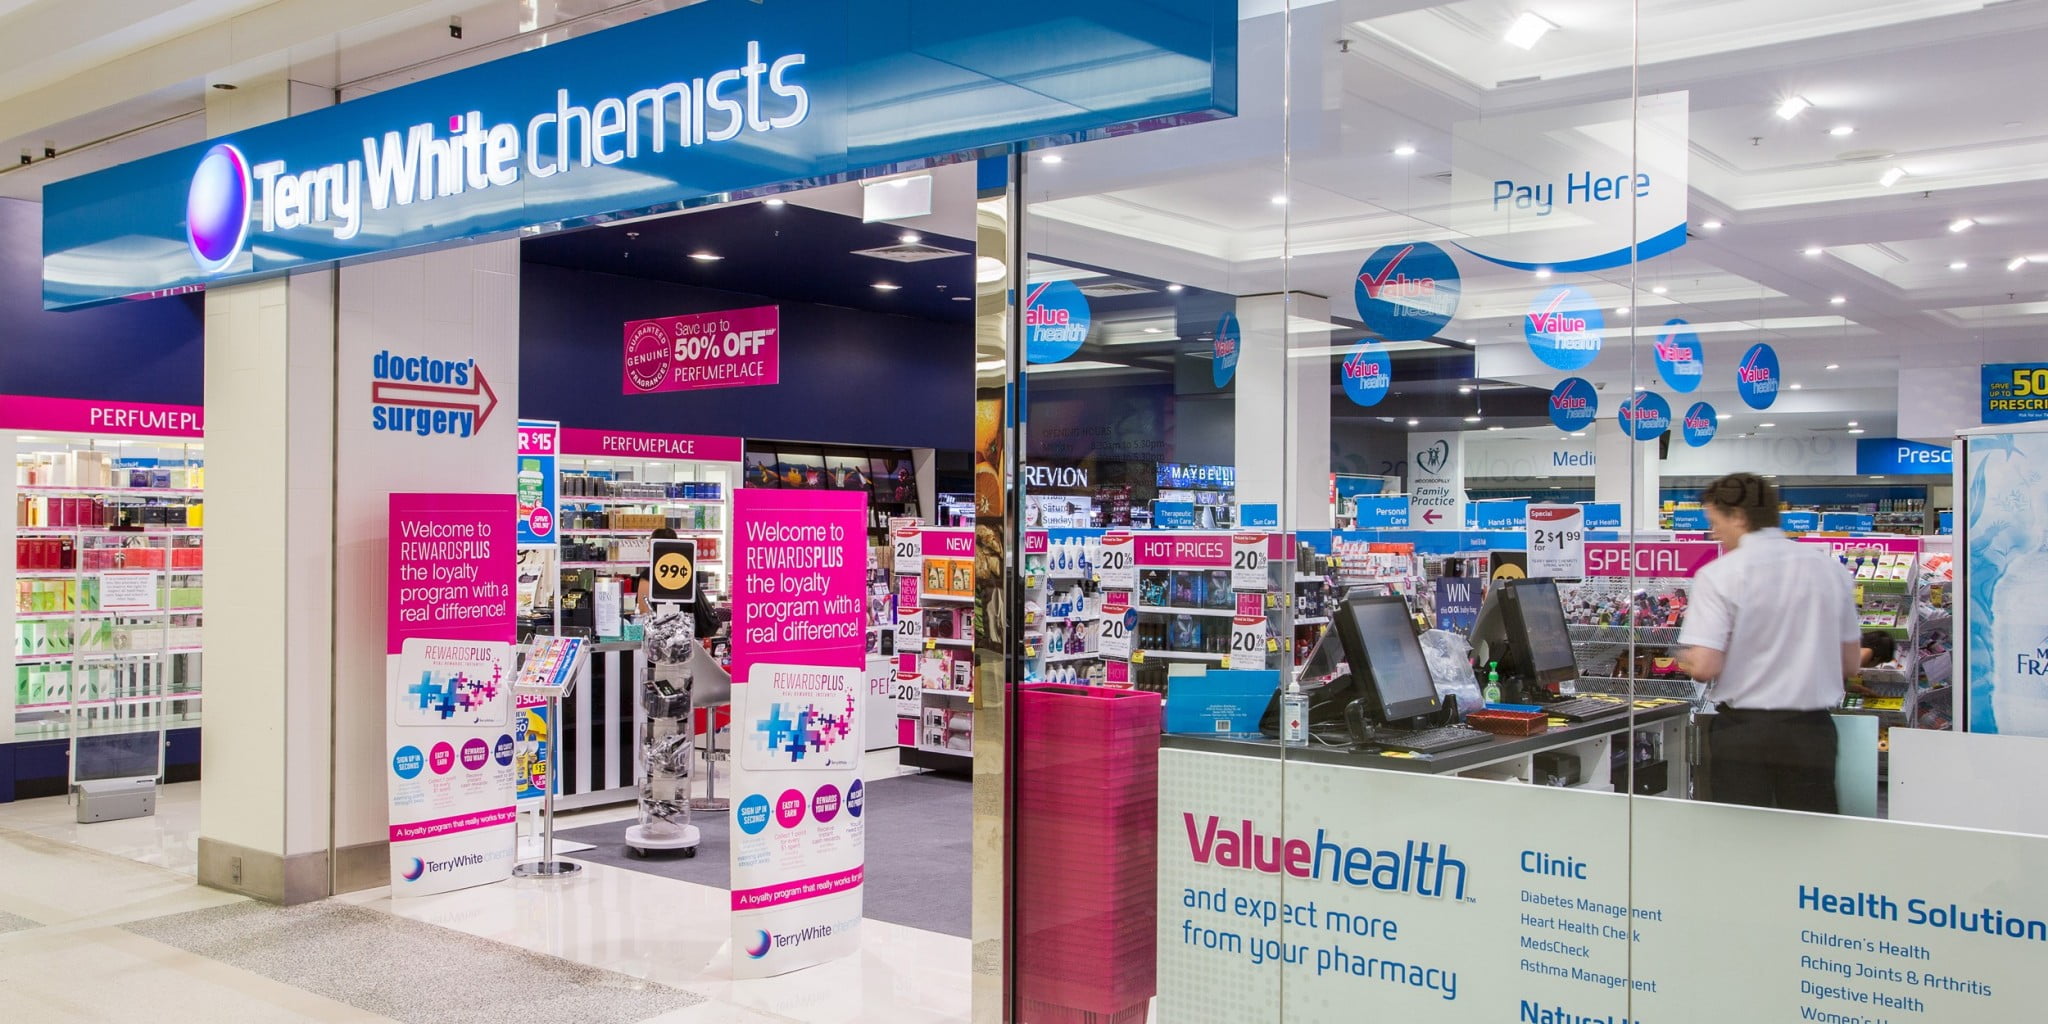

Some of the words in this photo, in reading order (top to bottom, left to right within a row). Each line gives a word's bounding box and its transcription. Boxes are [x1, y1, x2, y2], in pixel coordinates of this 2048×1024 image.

[527, 40, 808, 178] chemists
[1493, 180, 1553, 217] Pay
[1567, 171, 1651, 205] Here
[628, 326, 667, 353] GUARANTEED
[675, 322, 700, 336] Save
[703, 321, 717, 337] up
[720, 319, 730, 332] to
[1033, 324, 1086, 342] health
[674, 334, 720, 362] 50%
[723, 330, 766, 358] OFF
[1554, 331, 1601, 351] health
[373, 350, 474, 386] doctors'
[627, 347, 669, 367] GENUINE
[630, 362, 668, 388] FRAGRANCES
[1360, 373, 1390, 390] health
[1753, 378, 1779, 394] health
[2013, 369, 2048, 396] 50
[90, 407, 204, 431] PERFUMEPL
[372, 405, 473, 438] surgery
[1566, 405, 1595, 419] health
[1637, 415, 1669, 429] health
[532, 432, 551, 450] $15
[1025, 465, 1088, 488] REVLON
[1411, 496, 1455, 506] Practice
[1416, 487, 1450, 498] Family
[1161, 510, 1192, 518] Therapeutic
[1376, 507, 1407, 516] Personal
[1390, 517, 1407, 525] Care
[1531, 510, 1553, 518] Special
[1599, 518, 1619, 526] Health
[400, 520, 474, 538] Welcome
[477, 521, 491, 537] to
[746, 521, 826, 542] Welcome
[830, 522, 844, 542] to
[1534, 529, 1545, 544] 2
[401, 541, 491, 561] REWARDSPLUS
[946, 537, 972, 551] NEW
[1144, 542, 1173, 558] HOT
[1175, 542, 1224, 558] PRICES
[747, 546, 843, 570] REWARDSPLUS
[1588, 549, 1688, 572] SPECIAL
[400, 563, 428, 581] the
[432, 563, 478, 584] loyalty
[659, 564, 688, 579] 99¢
[400, 585, 468, 605] program
[472, 580, 499, 598] with
[501, 583, 509, 597] a
[746, 572, 775, 594] the
[780, 571, 831, 597] loyalty
[1446, 583, 1470, 602] WIN
[400, 603, 430, 622] real
[434, 599, 506, 621] difference!
[746, 600, 819, 624] program
[823, 595, 851, 615] with
[854, 597, 861, 613] a
[746, 621, 778, 644] real
[783, 617, 859, 641] difference!
[396, 829, 403, 837] A
[404, 825, 426, 836] loyalty
[427, 822, 452, 834] program
[453, 819, 465, 828] that
[465, 817, 480, 827] really
[481, 814, 498, 822] works
[1520, 850, 1587, 880] Clinic
[740, 895, 748, 904] A
[749, 892, 773, 904] loyalty
[774, 888, 801, 901] program
[802, 884, 816, 893] that
[816, 880, 833, 890] really
[834, 876, 850, 887] works
[1520, 890, 1574, 909] Diabetes
[1183, 887, 1226, 913] and
[1235, 896, 1318, 929] expect
[1326, 911, 1398, 941] more
[1520, 913, 1555, 930] Heart
[1558, 919, 1599, 936] Health
[1799, 885, 1898, 921] Health
[1907, 898, 2047, 942] Solution
[1520, 935, 1590, 958] MedsCheck
[1801, 930, 1875, 953] Children's
[1879, 941, 1930, 961] Health
[1183, 920, 1241, 954] from
[1250, 936, 1309, 965] your
[1317, 946, 1457, 1001] pharmacy
[1520, 959, 1568, 978] Asthma
[1801, 955, 1851, 978] Aching
[1855, 964, 1903, 983] Joints
[1906, 971, 1919, 985] &
[1923, 973, 1992, 997] Arthritis
[1801, 980, 1868, 1004] Digestive
[1872, 991, 1924, 1013] Health
